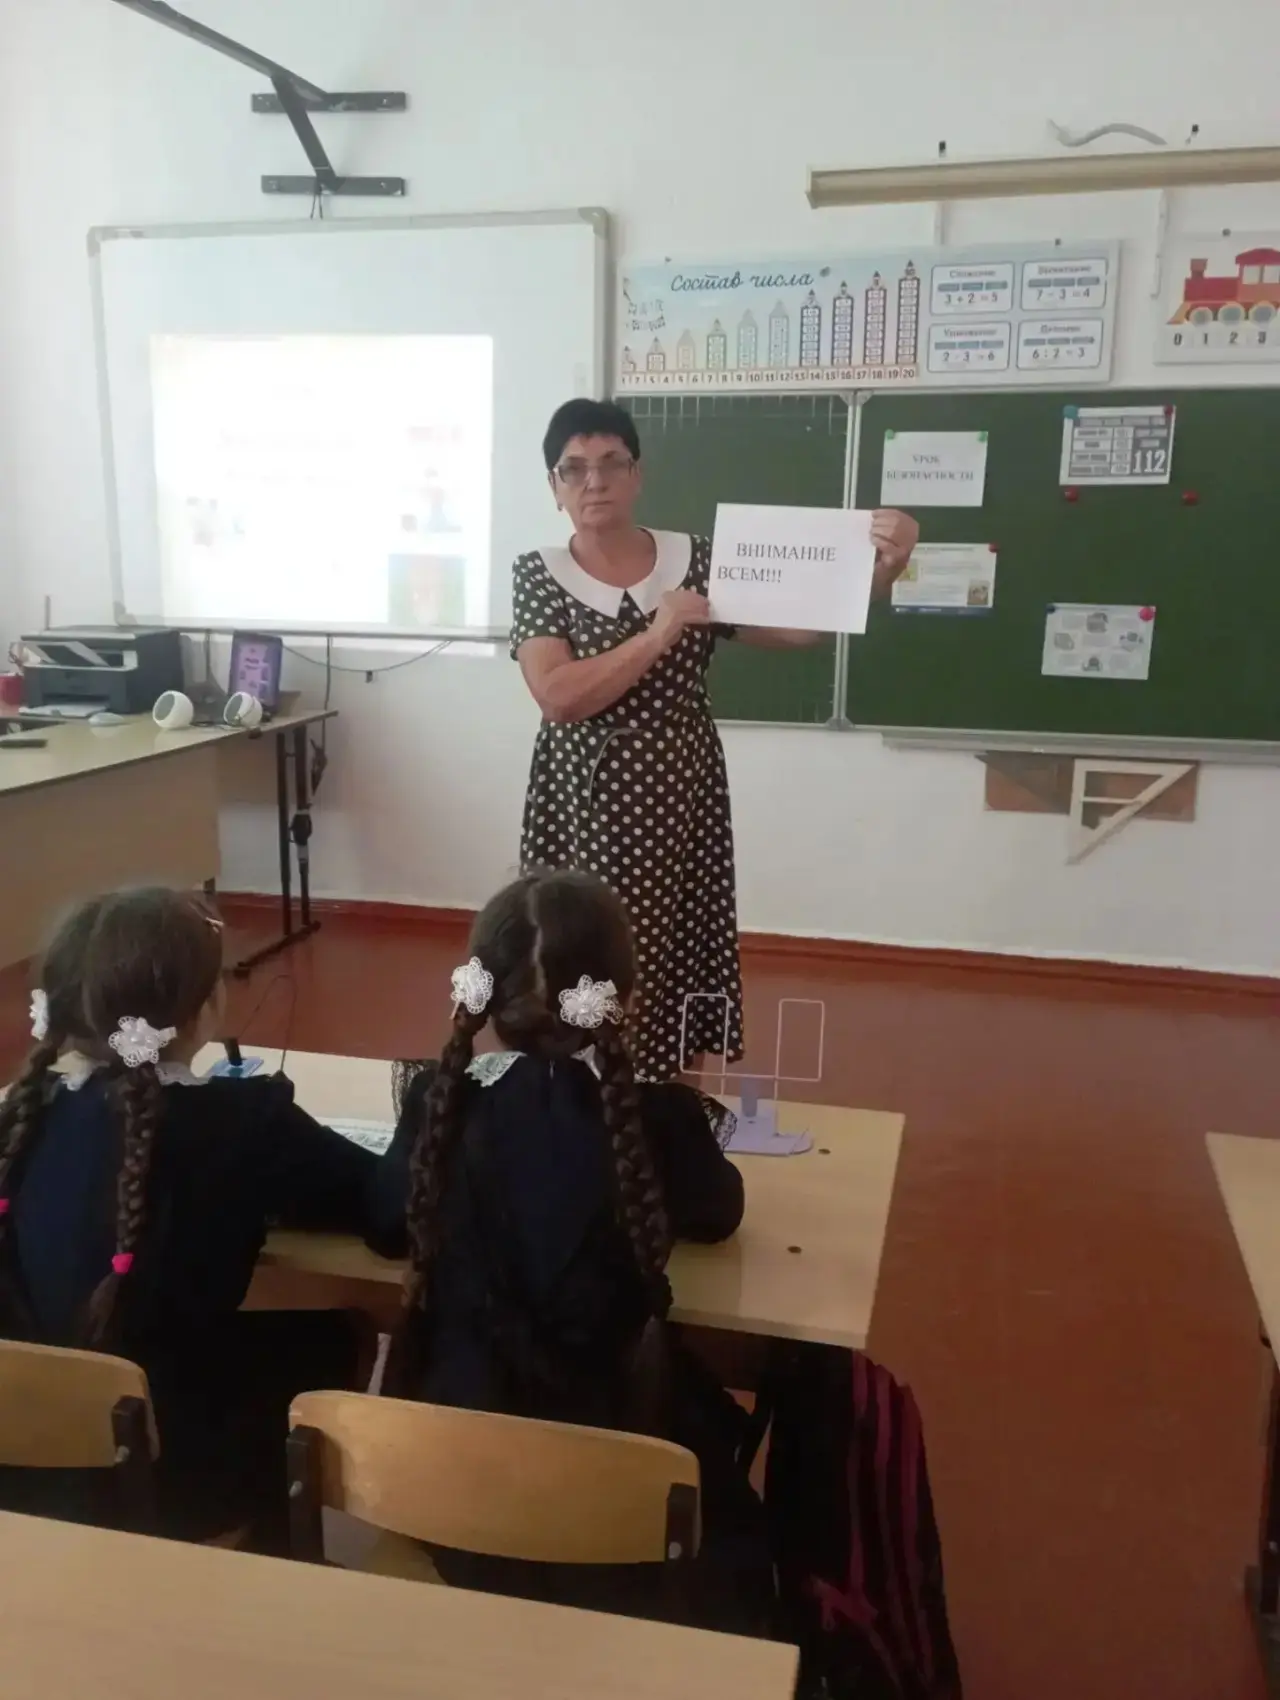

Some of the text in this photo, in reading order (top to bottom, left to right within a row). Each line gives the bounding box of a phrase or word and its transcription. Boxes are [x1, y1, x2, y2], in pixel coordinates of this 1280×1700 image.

[671, 271, 814, 292] Состав числа
[1173, 332, 1182, 346] 0
[1203, 333, 1208, 345] 1
[1229, 331, 1238, 344] 2
[750, 373, 760, 383] 10
[780, 373, 790, 381] 12
[810, 372, 820, 380] 14
[856, 371, 867, 379] 17
[872, 370, 882, 379] 18
[888, 370, 898, 379] 19
[902, 369, 914, 378] 20
[1132, 449, 1166, 473] 112
[736, 542, 837, 562] ВНИМАНИЕ
[717, 565, 782, 583] ВСЕМ!!!
